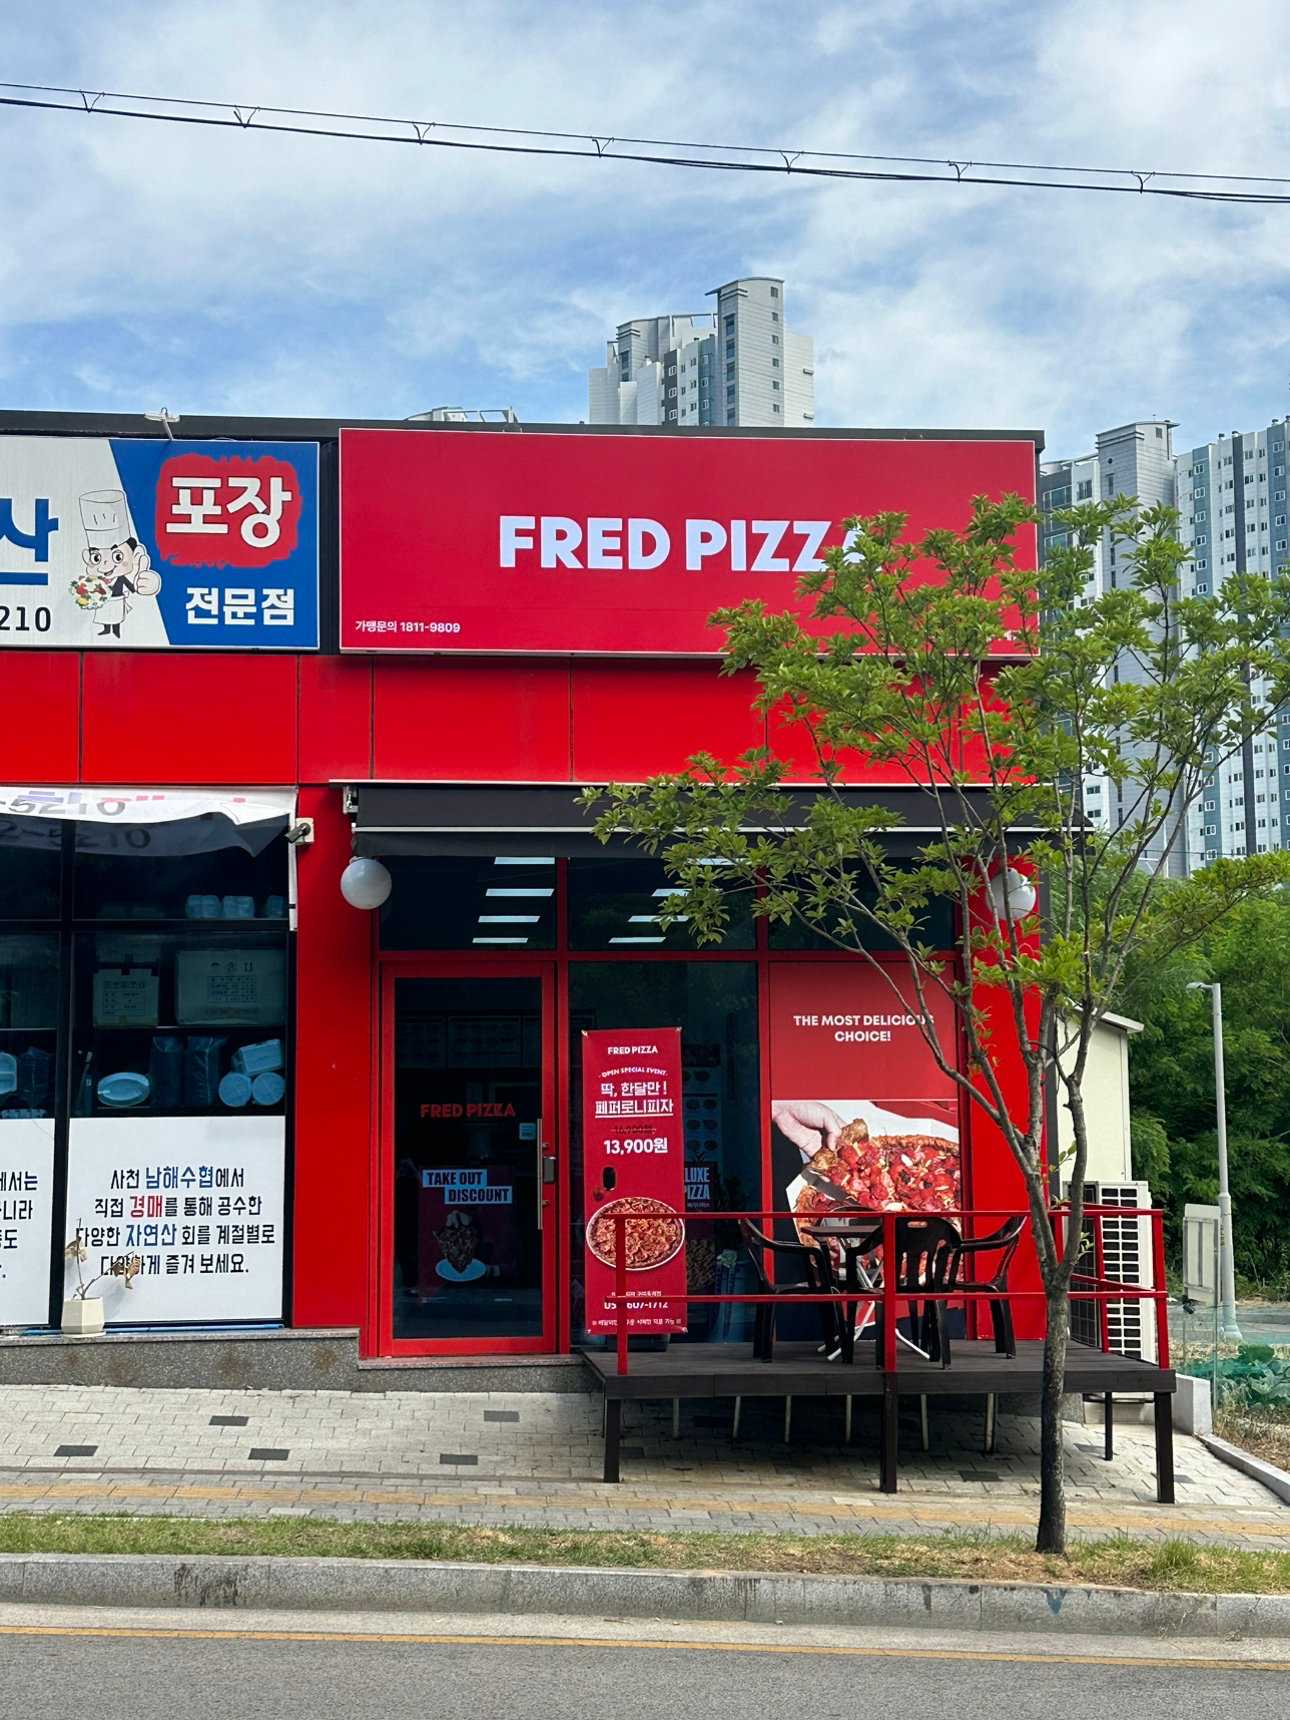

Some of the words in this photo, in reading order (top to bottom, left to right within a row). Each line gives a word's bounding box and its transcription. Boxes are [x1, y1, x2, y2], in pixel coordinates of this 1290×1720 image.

[166, 475, 293, 549] 포장
[499, 515, 671, 570] FRED
[185, 587, 295, 626] 전문점
[355, 620, 398, 633] 가맹문의
[400, 621, 461, 633] 1811-9809
[793, 1015, 819, 1026] THE
[821, 1015, 861, 1026] MOST
[834, 1030, 892, 1042] CHOICE!
[607, 1046, 631, 1055] FRED
[632, 1045, 659, 1054] PIZZA
[601, 1068, 620, 1078] OPEN
[620, 1066, 645, 1074] SPECIAL
[601, 1083, 618, 1097] 딱,
[420, 1103, 463, 1118] FRED
[466, 1103, 516, 1117] PIZZA
[595, 1098, 674, 1115] 페퍼로니피자
[603, 1137, 669, 1156] 13,900원
[110, 1169, 141, 1190] 사천
[145, 1165, 245, 1189] 남해수협에서
[427, 1172, 457, 1186] TAKE
[459, 1171, 483, 1185] OUT
[448, 1188, 510, 1203] DISCOUNT
[94, 1198, 124, 1219] 직접
[129, 1195, 179, 1218] 경매를
[183, 1196, 213, 1218] 통해
[217, 1195, 263, 1217] 공수한
[126, 1223, 177, 1247] 자연산
[181, 1225, 211, 1246] 회를
[216, 1223, 276, 1246] 계절별로
[165, 1253, 195, 1275] 즐겨
[199, 1253, 249, 1275] 보세요.
